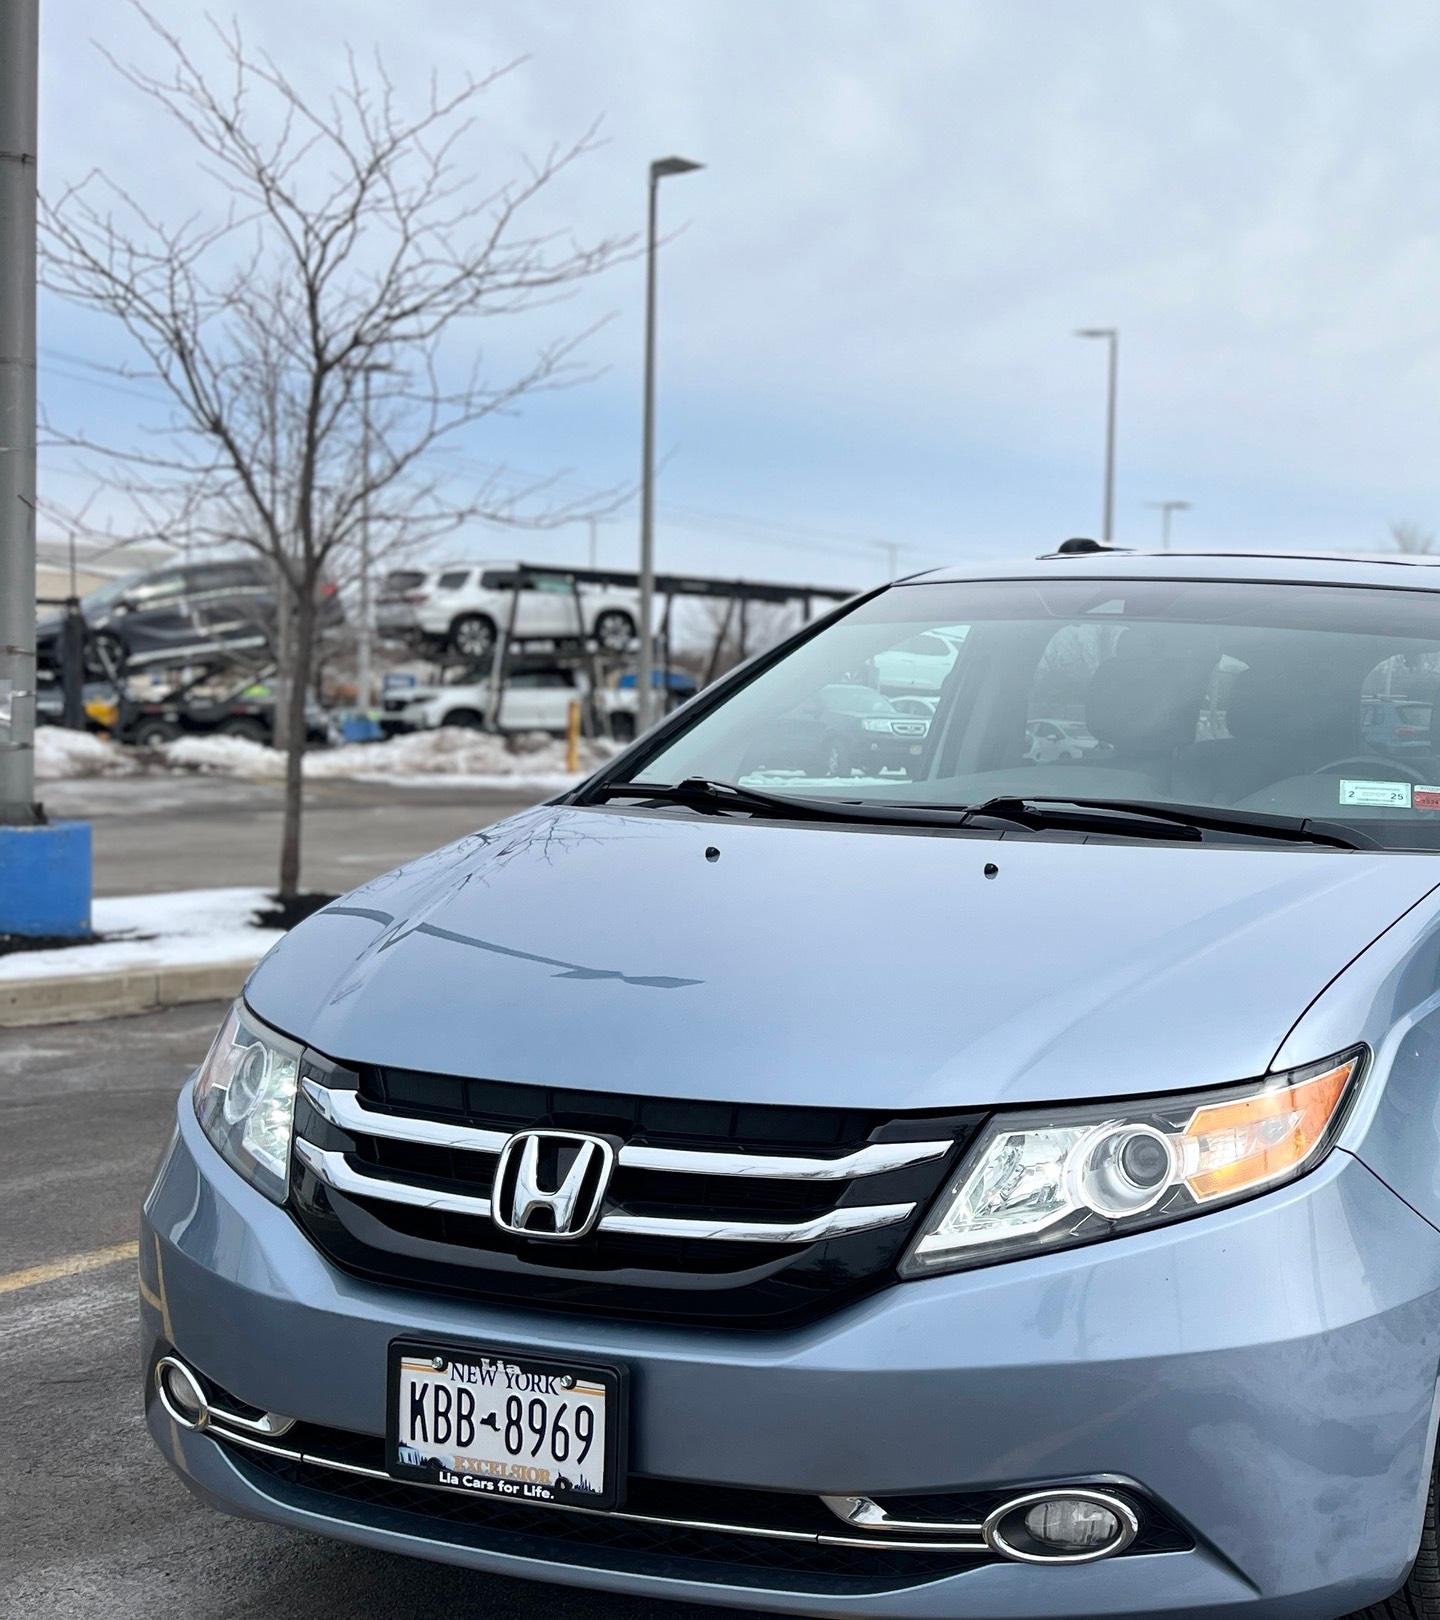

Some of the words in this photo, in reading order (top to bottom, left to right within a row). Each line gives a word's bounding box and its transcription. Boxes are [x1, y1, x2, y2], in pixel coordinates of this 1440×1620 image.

[1391, 793, 1404, 801] 25
[450, 1361, 498, 1387] NEW
[505, 1371, 559, 1396] YORK
[453, 1456, 551, 1484] EXCELSIOR
[439, 1471, 459, 1485] Lia
[462, 1475, 494, 1491] Cars
[498, 1480, 520, 1494] for
[523, 1484, 555, 1499] Life.
